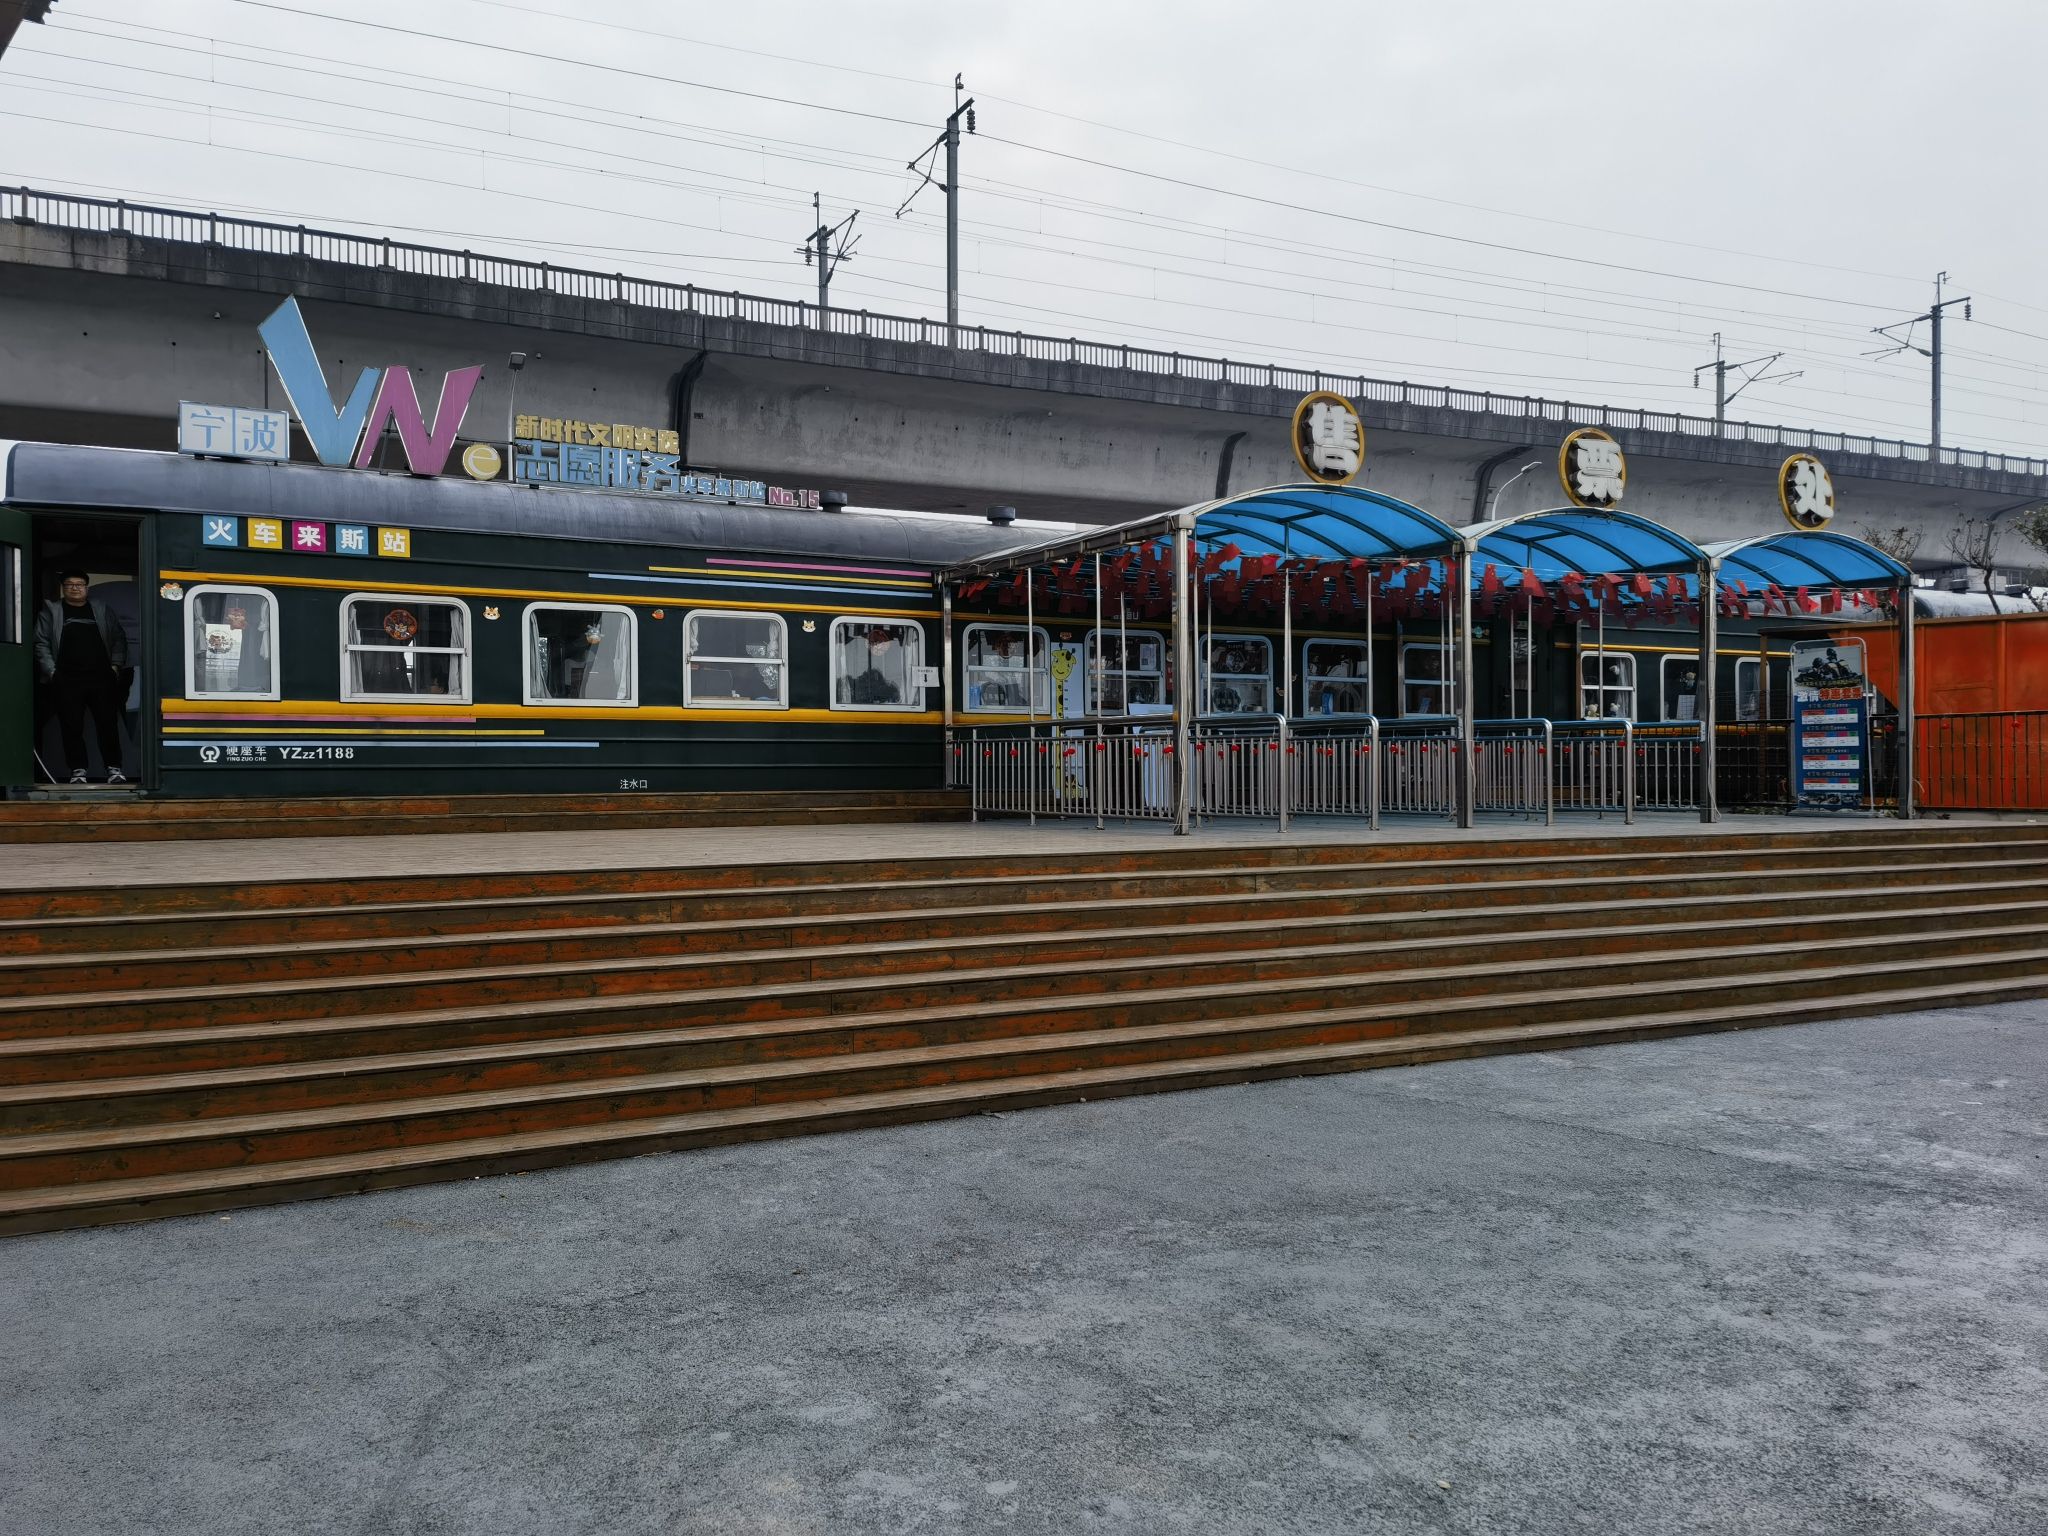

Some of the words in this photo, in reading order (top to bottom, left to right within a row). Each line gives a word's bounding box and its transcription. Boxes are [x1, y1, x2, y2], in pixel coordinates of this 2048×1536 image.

[189, 408, 280, 456] 宁波
[515, 414, 680, 455] 新时代文明实践
[515, 438, 681, 493] 志愿服务
[680, 474, 767, 500] 火车来斯站
[768, 486, 820, 509] No.15
[207, 519, 407, 553] 火车来斯站
[226, 746, 267, 756] 硬座车
[619, 779, 648, 790] 注水口
